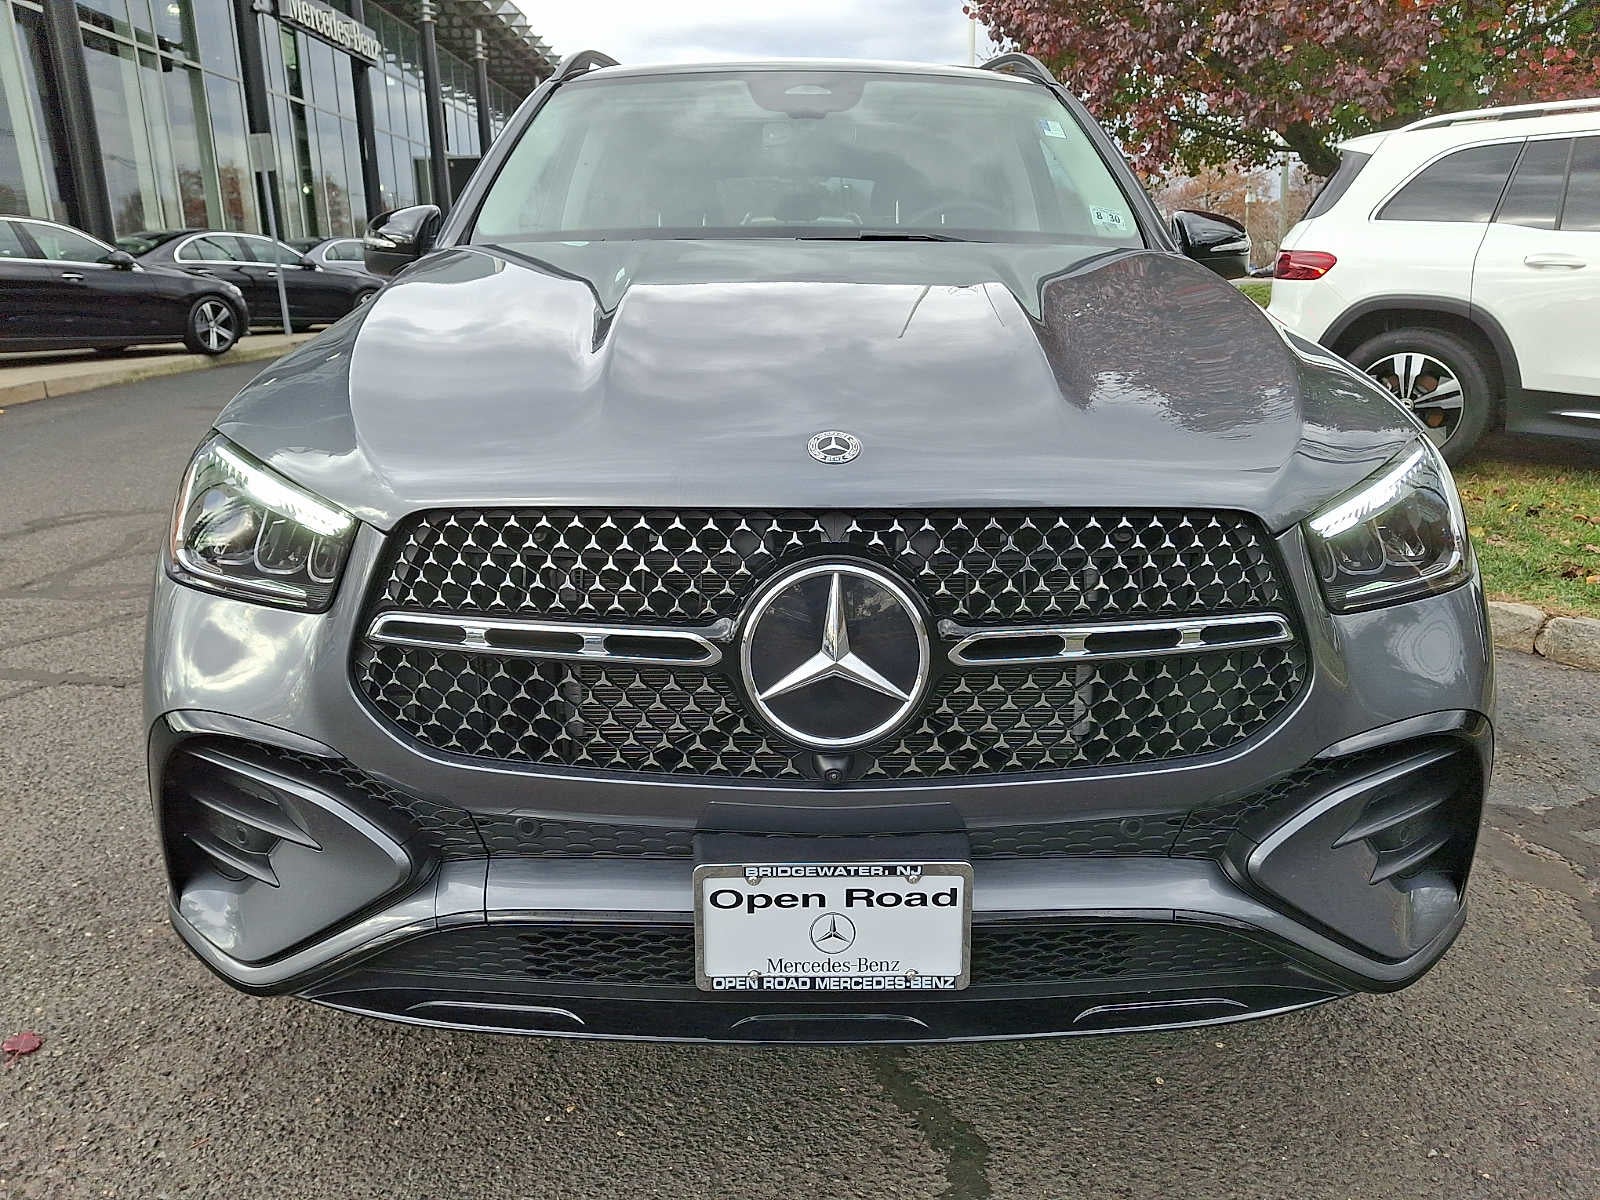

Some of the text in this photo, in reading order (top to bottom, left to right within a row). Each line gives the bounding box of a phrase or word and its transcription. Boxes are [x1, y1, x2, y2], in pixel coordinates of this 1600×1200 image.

[896, 866, 922, 876] NJ
[709, 888, 958, 913] Open Road
[767, 958, 900, 973] Mercedes-Benz
[713, 977, 955, 990] OPEN ROAD MERCEDES-BENZ
